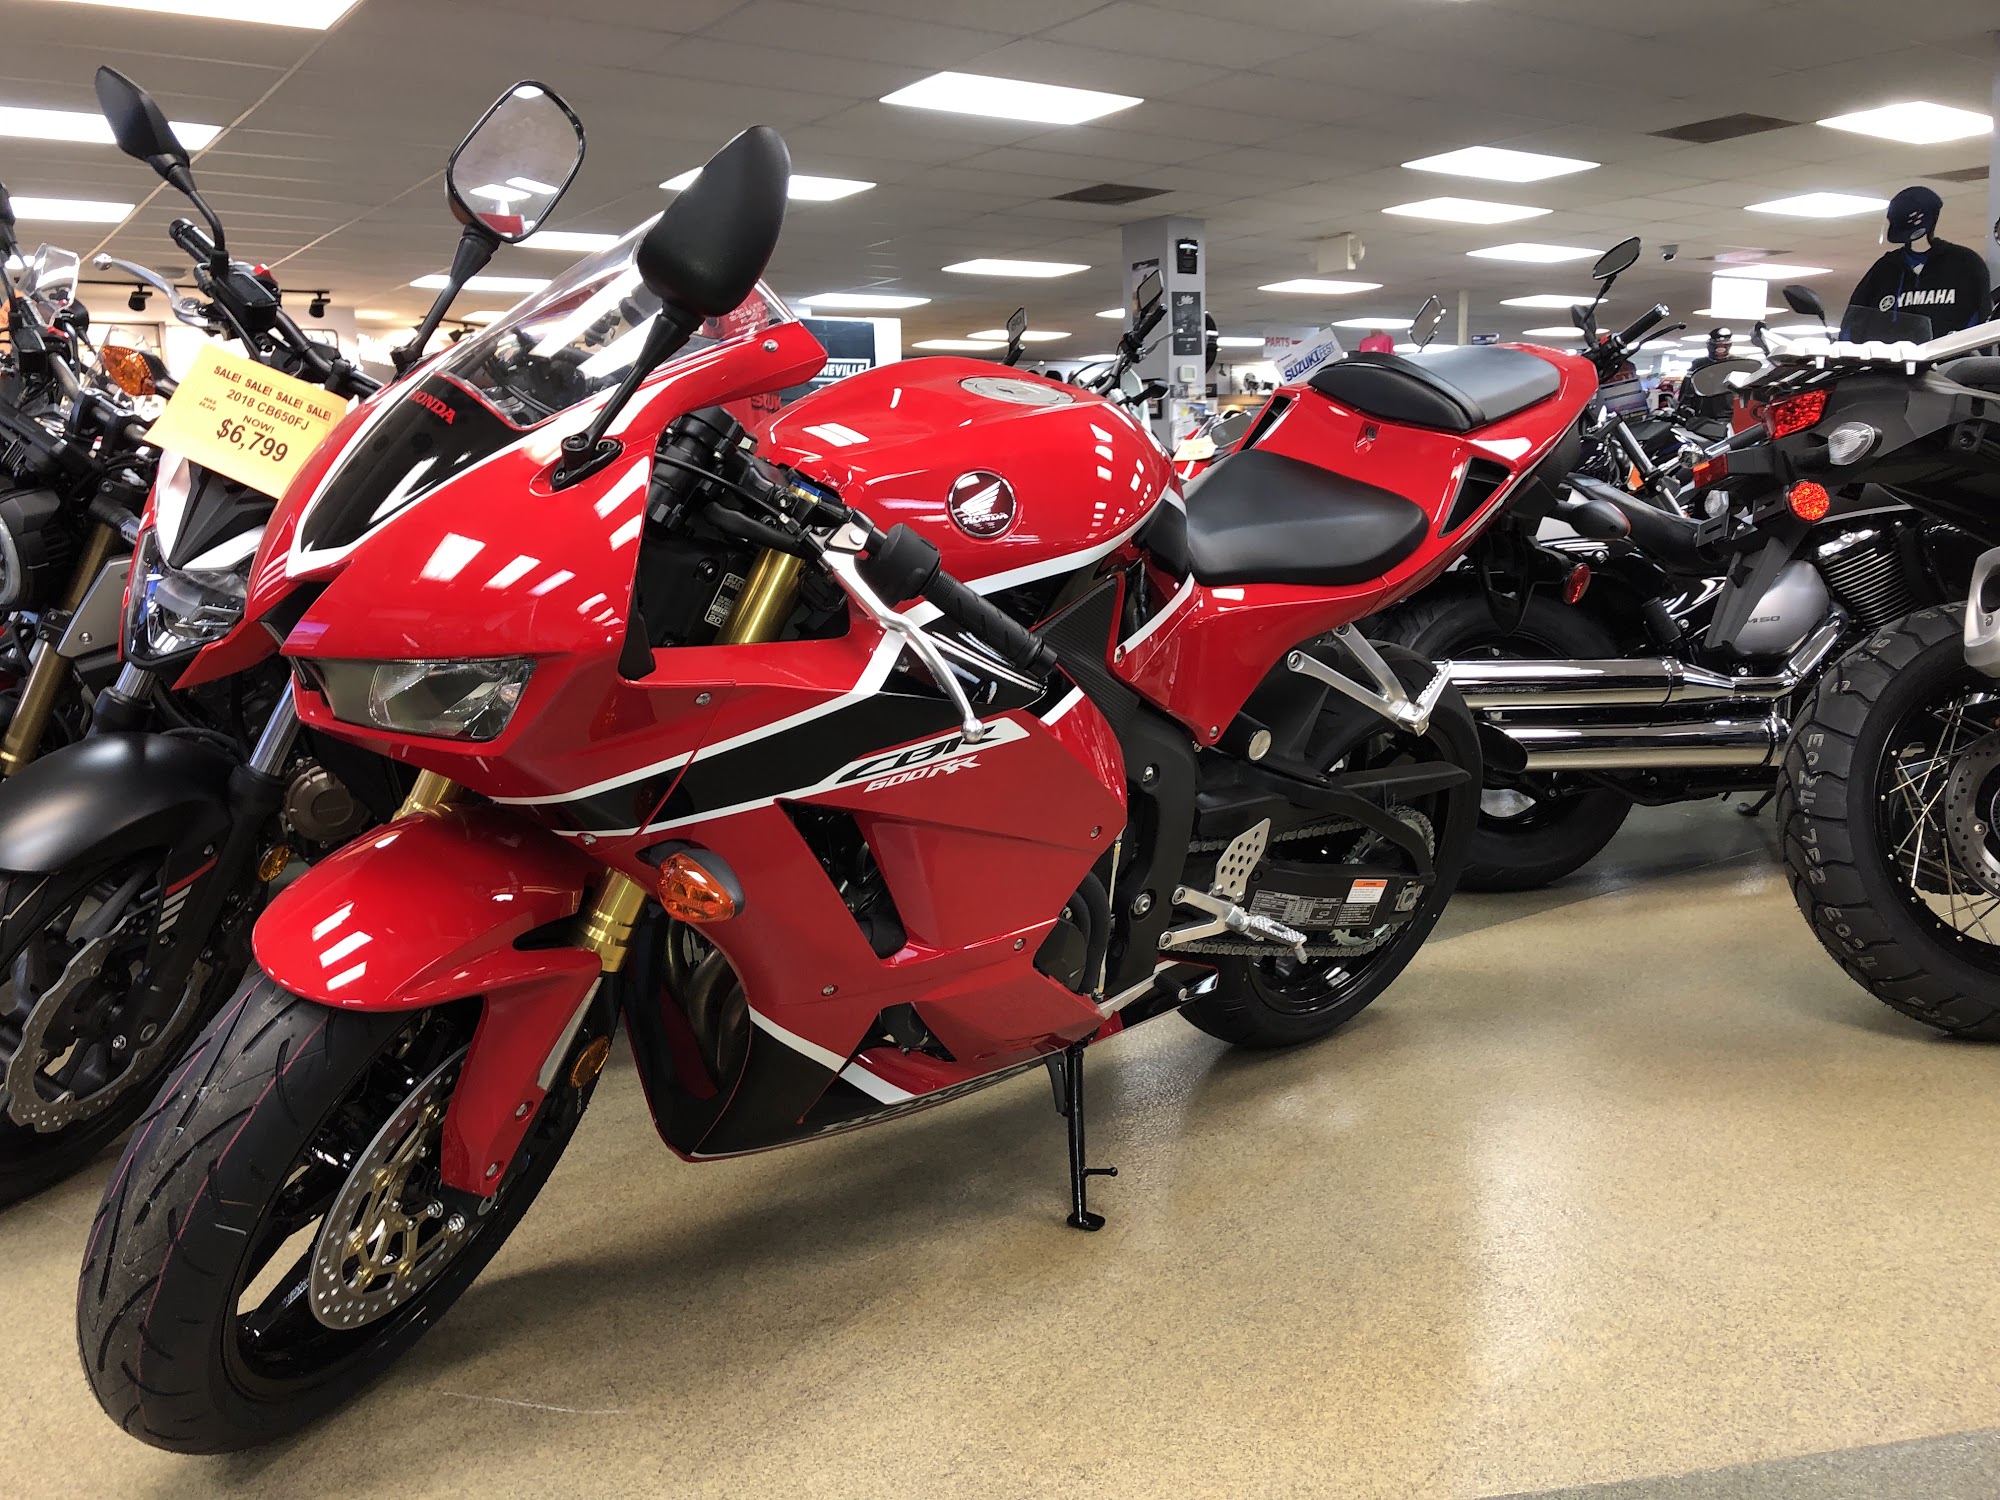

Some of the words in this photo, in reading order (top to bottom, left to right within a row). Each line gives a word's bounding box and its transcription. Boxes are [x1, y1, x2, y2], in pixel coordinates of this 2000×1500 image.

[1897, 289, 1956, 308] YAMAHA
[1265, 337, 1290, 347] PARTS
[1284, 349, 1321, 382] SUZUKI
[213, 365, 242, 384] SALE!
[244, 378, 273, 397] SALE!
[275, 391, 304, 410] SALE!
[306, 403, 332, 422] SALE!
[226, 388, 255, 408] 2018
[257, 401, 310, 431] CB650FJ
[216, 418, 289, 462] $6,799
[242, 415, 275, 433] NOW!
[962, 512, 1009, 525] HONDA
[863, 755, 982, 793] 600RR
